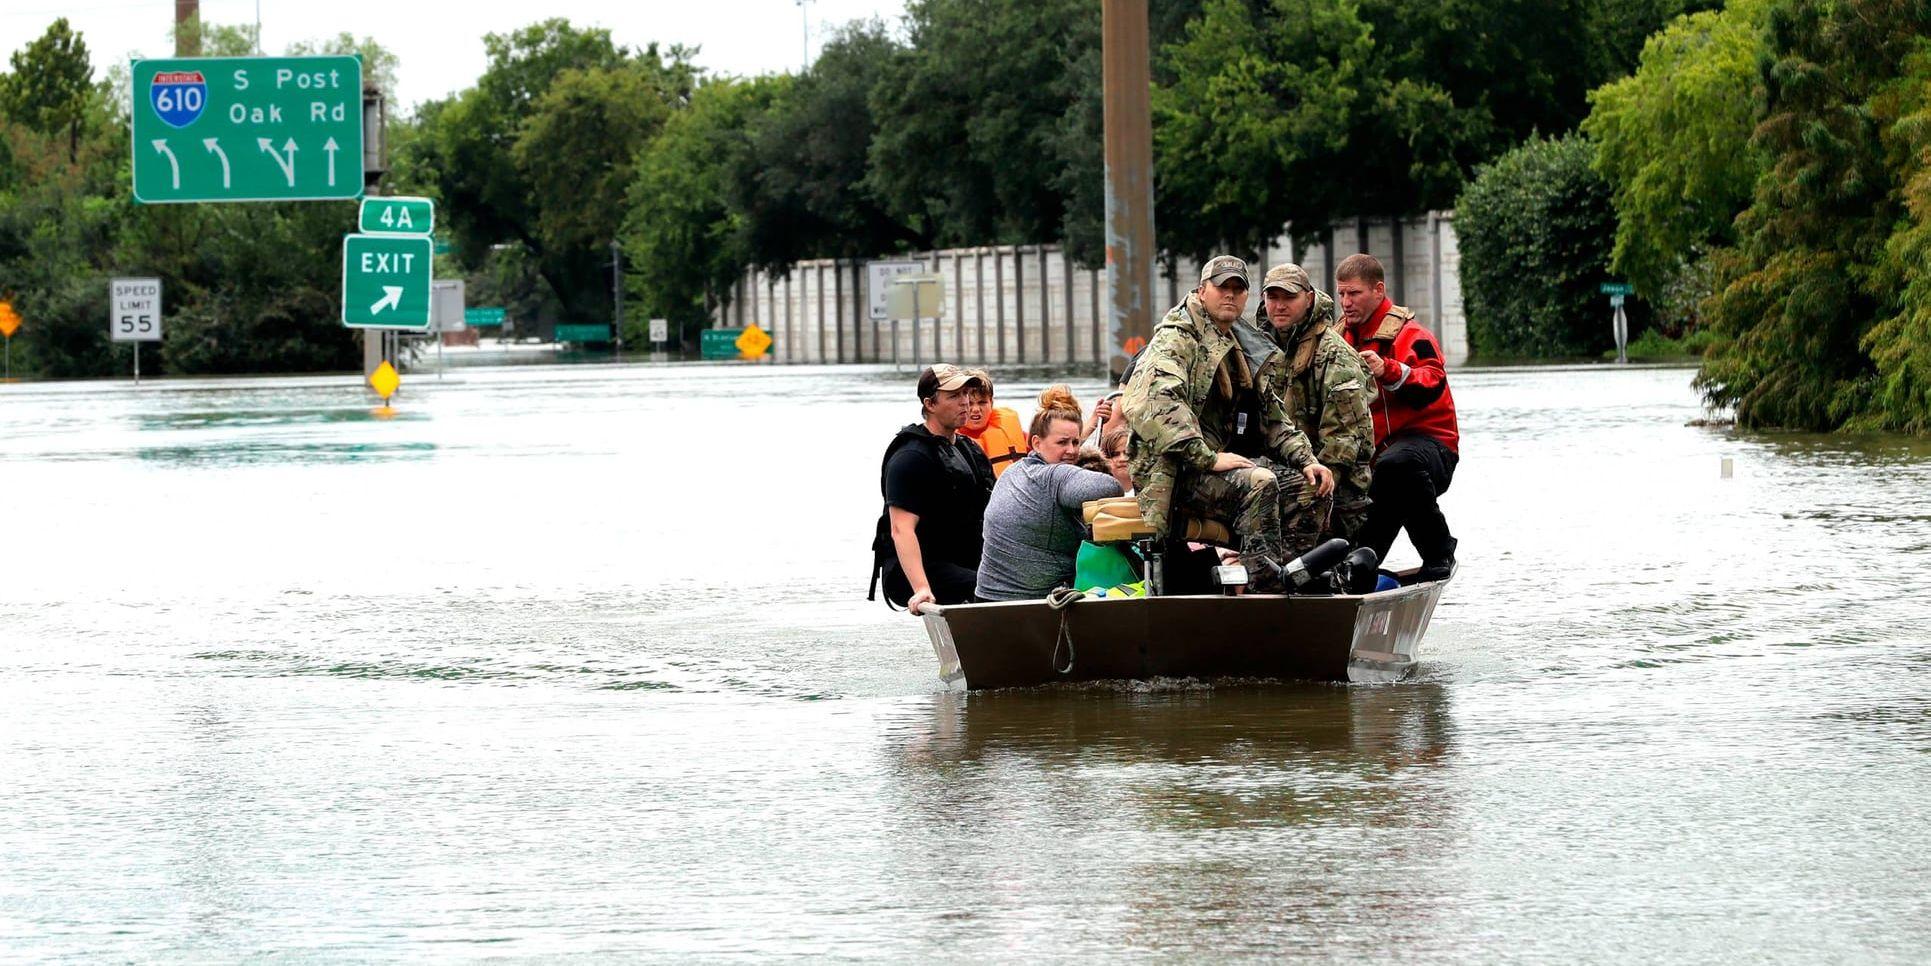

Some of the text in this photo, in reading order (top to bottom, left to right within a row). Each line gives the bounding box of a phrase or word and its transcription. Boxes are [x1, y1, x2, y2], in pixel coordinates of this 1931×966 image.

[233, 68, 340, 90] S Post
[156, 87, 201, 112] 610
[229, 101, 345, 124] Oak Rd
[380, 205, 413, 229] 4A
[361, 252, 415, 274] EXIT
[115, 286, 157, 296] SPEED
[120, 300, 151, 310] LIMIT
[121, 315, 152, 333] 55
